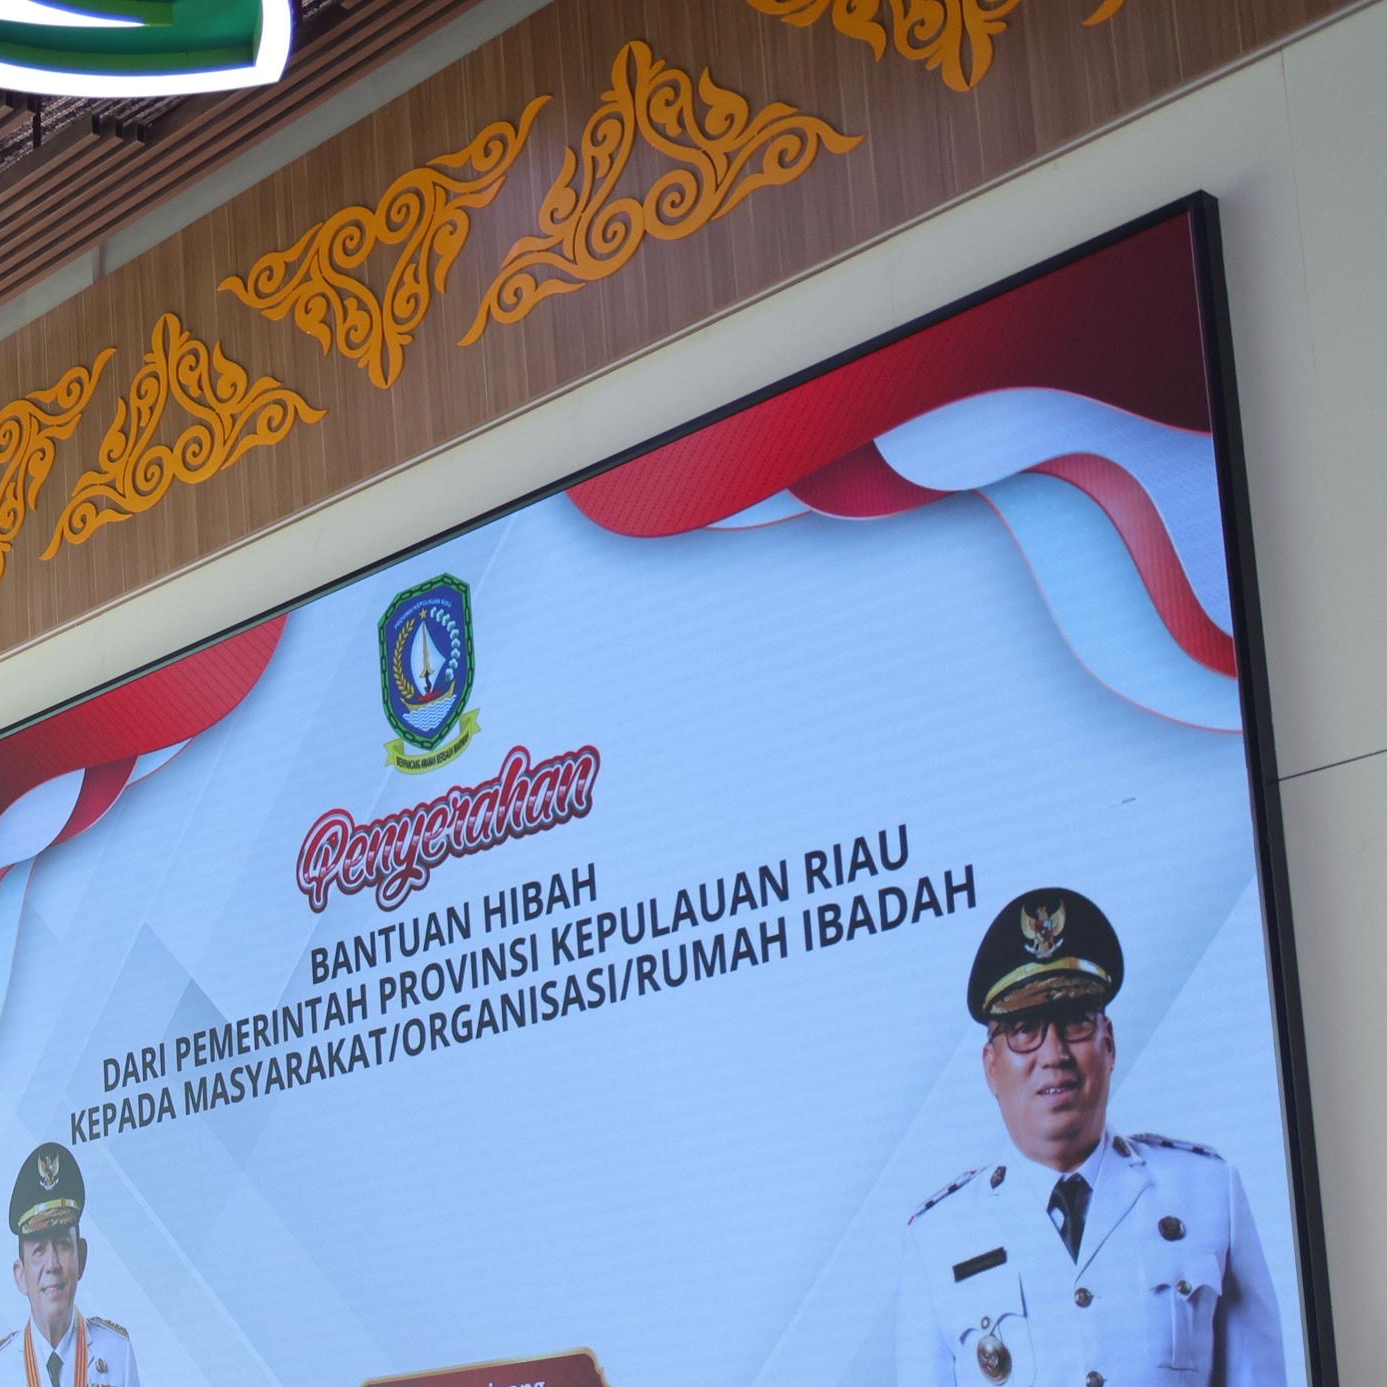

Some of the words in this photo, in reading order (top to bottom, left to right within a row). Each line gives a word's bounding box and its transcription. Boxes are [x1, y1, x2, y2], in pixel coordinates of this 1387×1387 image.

[299, 748, 598, 909] Penyerahan
[311, 902, 472, 985] BANTUAN
[483, 862, 598, 933] HIBAH
[70, 1086, 177, 1145] KEPADA
[184, 917, 789, 1116] MASYARAKAT/ORGANISASI/RUMAH
[803, 863, 978, 952] IBADAH
[102, 1042, 167, 1093] DARI
[176, 982, 368, 1072] PEMERINTAH
[379, 933, 540, 1015] PROVINSI
[552, 859, 791, 966] KEPULAUAN
[804, 823, 910, 894] RIAU
